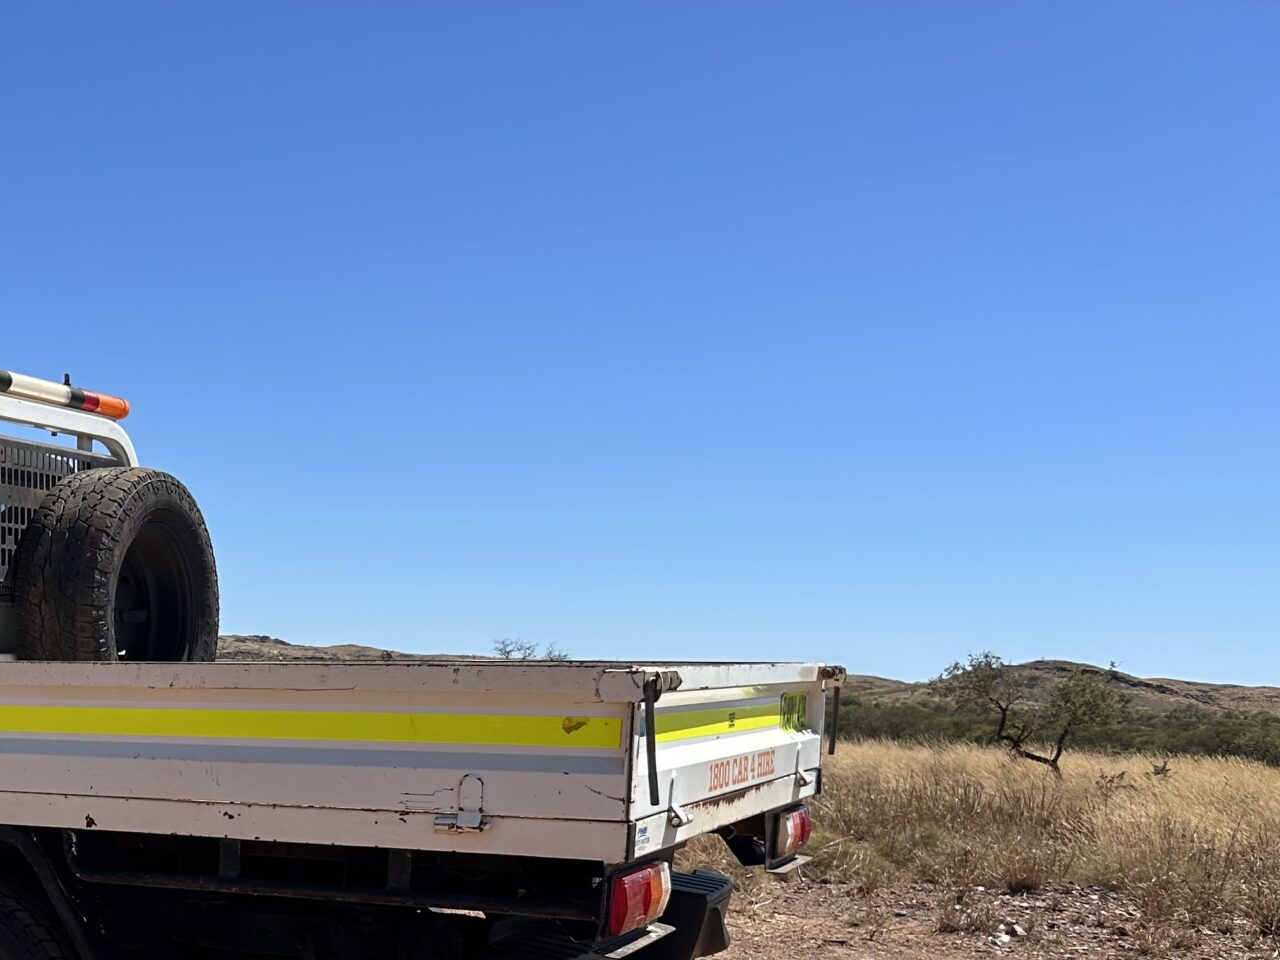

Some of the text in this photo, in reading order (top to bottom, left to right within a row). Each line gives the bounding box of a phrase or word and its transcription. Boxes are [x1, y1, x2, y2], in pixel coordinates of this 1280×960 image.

[709, 750, 775, 792] 1800 CAR 4 HIRE
